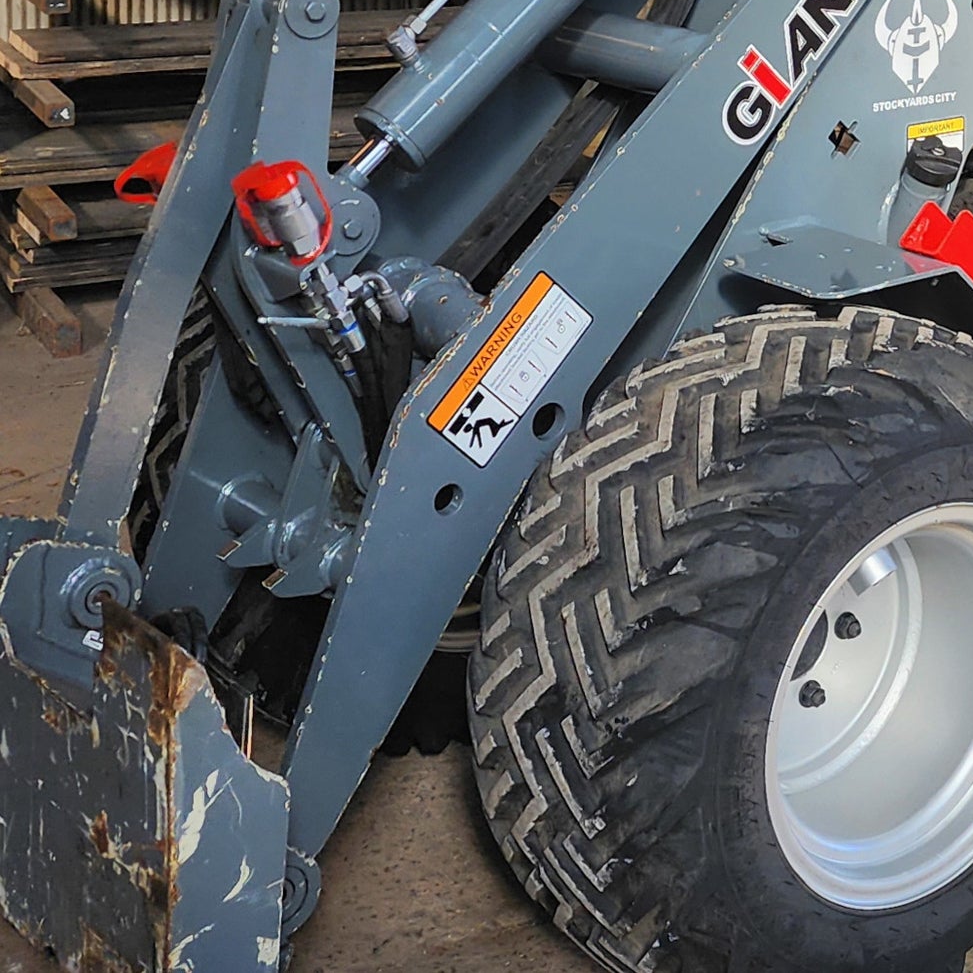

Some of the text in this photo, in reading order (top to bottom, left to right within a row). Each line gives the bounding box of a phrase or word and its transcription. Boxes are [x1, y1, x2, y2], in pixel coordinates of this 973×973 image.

[872, 91, 957, 113] STOCKYARDS CITY
[917, 121, 955, 134] IMPORTANT
[471, 312, 522, 377] WARNING
